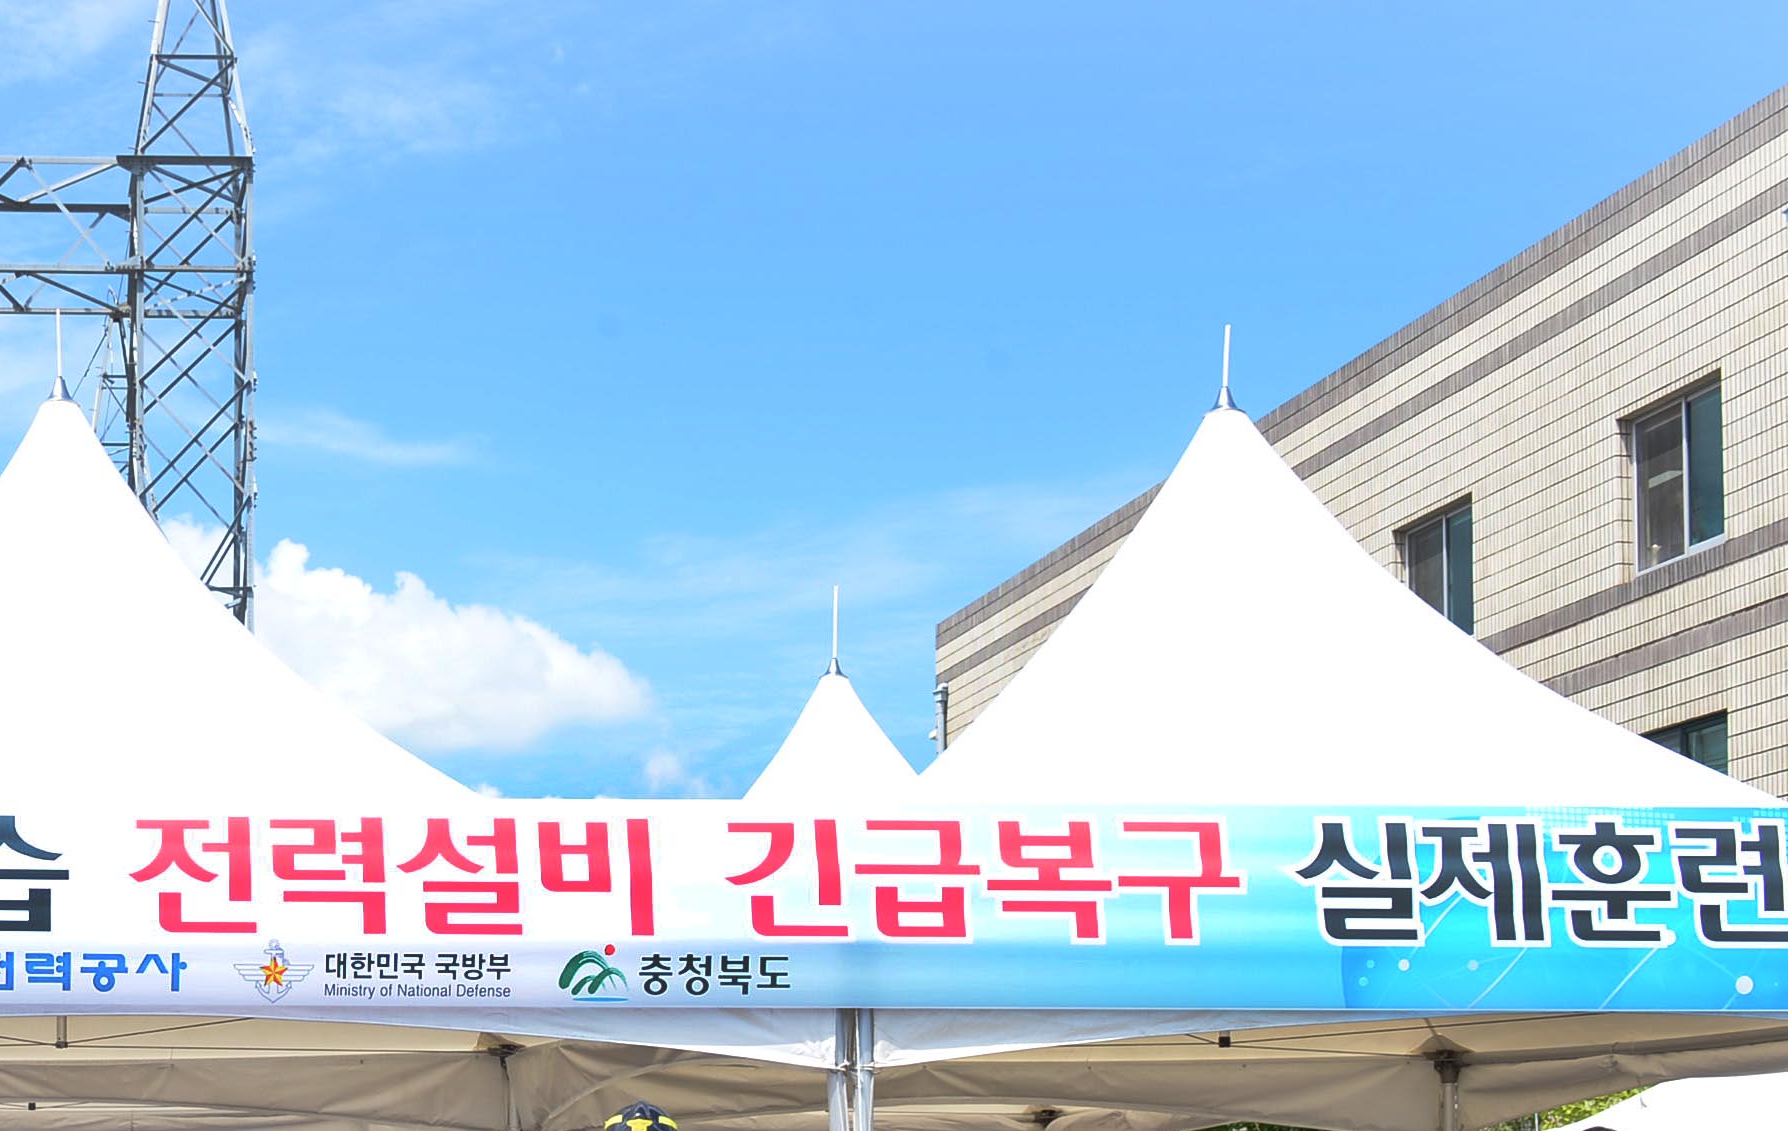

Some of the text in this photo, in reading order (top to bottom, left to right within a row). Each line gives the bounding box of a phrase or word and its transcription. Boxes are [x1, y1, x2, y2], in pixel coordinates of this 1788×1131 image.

[129, 816, 655, 936] 전력설비
[724, 818, 1241, 940] 긴급복구
[1295, 821, 1788, 943] 실제훈련
[325, 952, 512, 981] 대한민국 국방부
[638, 953, 792, 998] 충청북도
[324, 984, 512, 1000] Ministry of National Defense
